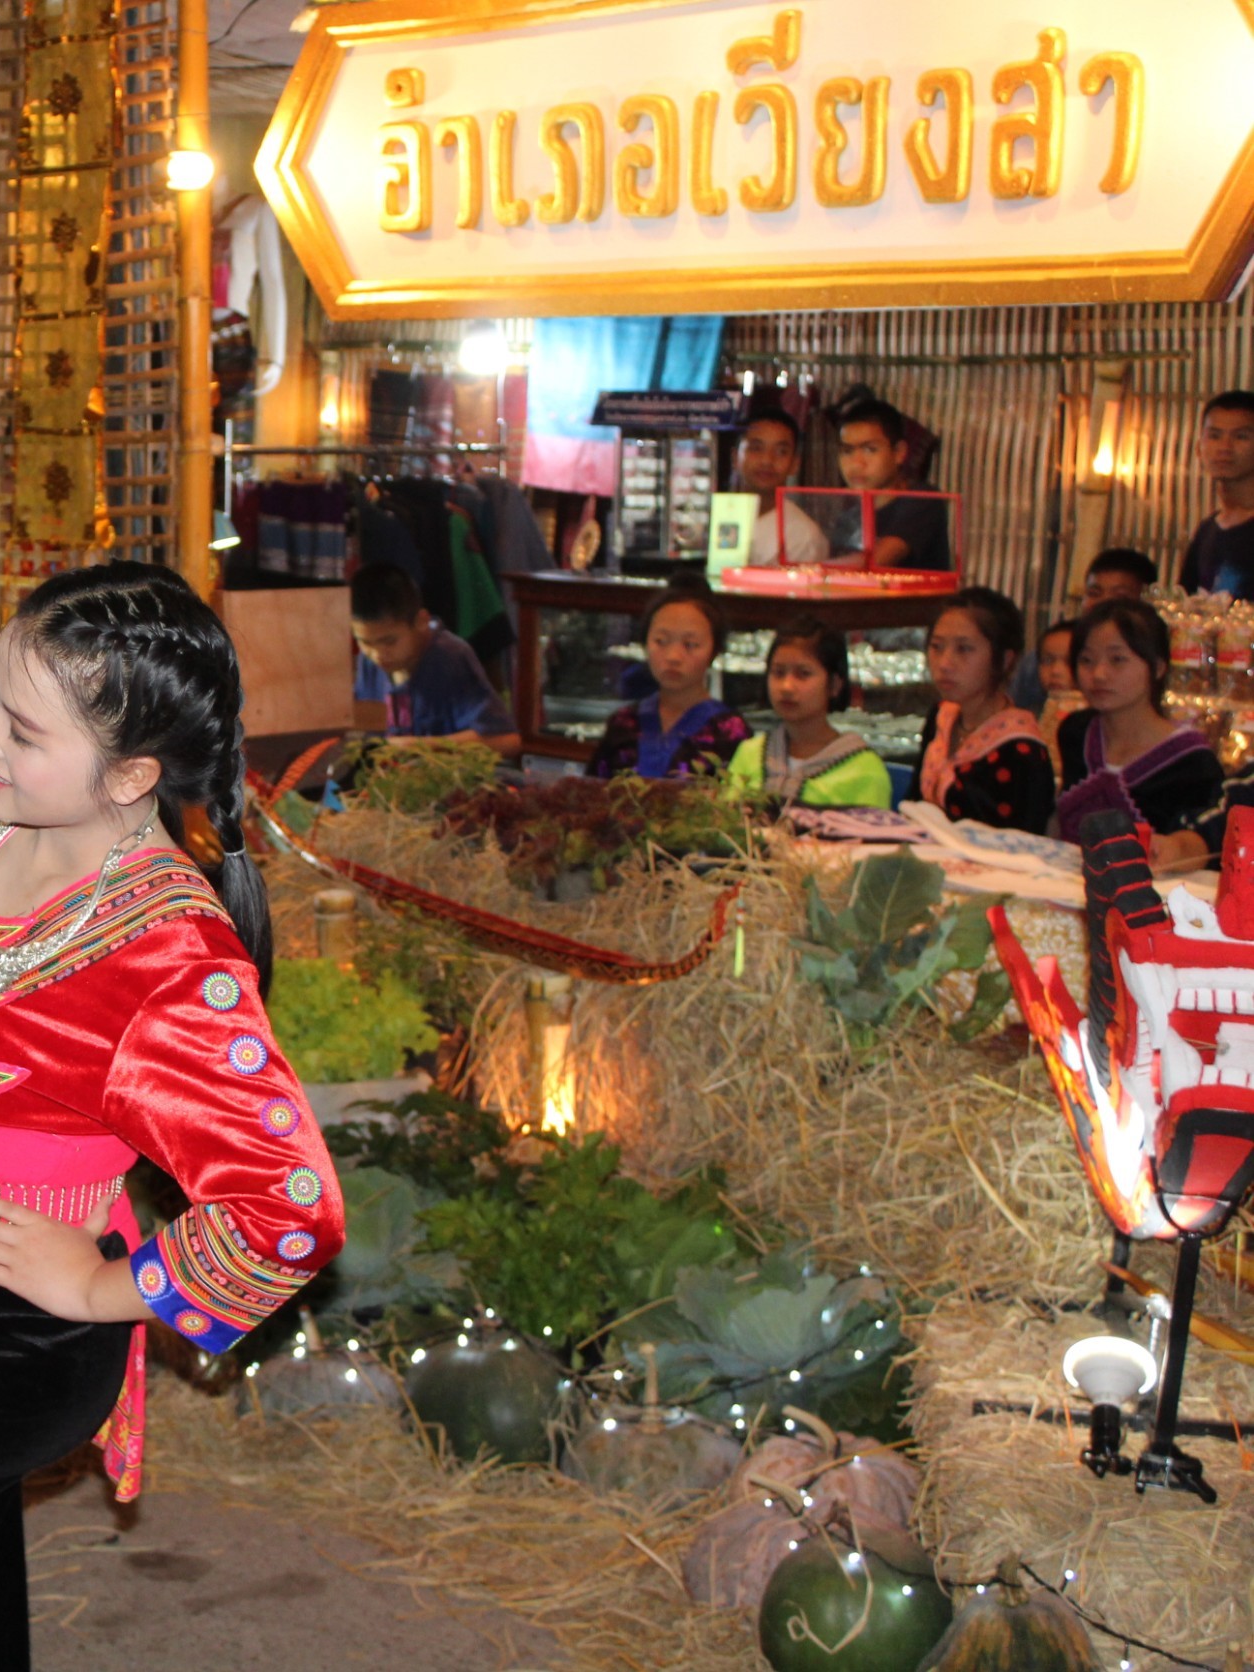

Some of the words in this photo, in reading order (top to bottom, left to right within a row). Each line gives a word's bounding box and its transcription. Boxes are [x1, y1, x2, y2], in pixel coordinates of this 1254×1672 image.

[377, 9, 1144, 232] อำเภอเวียงสา
